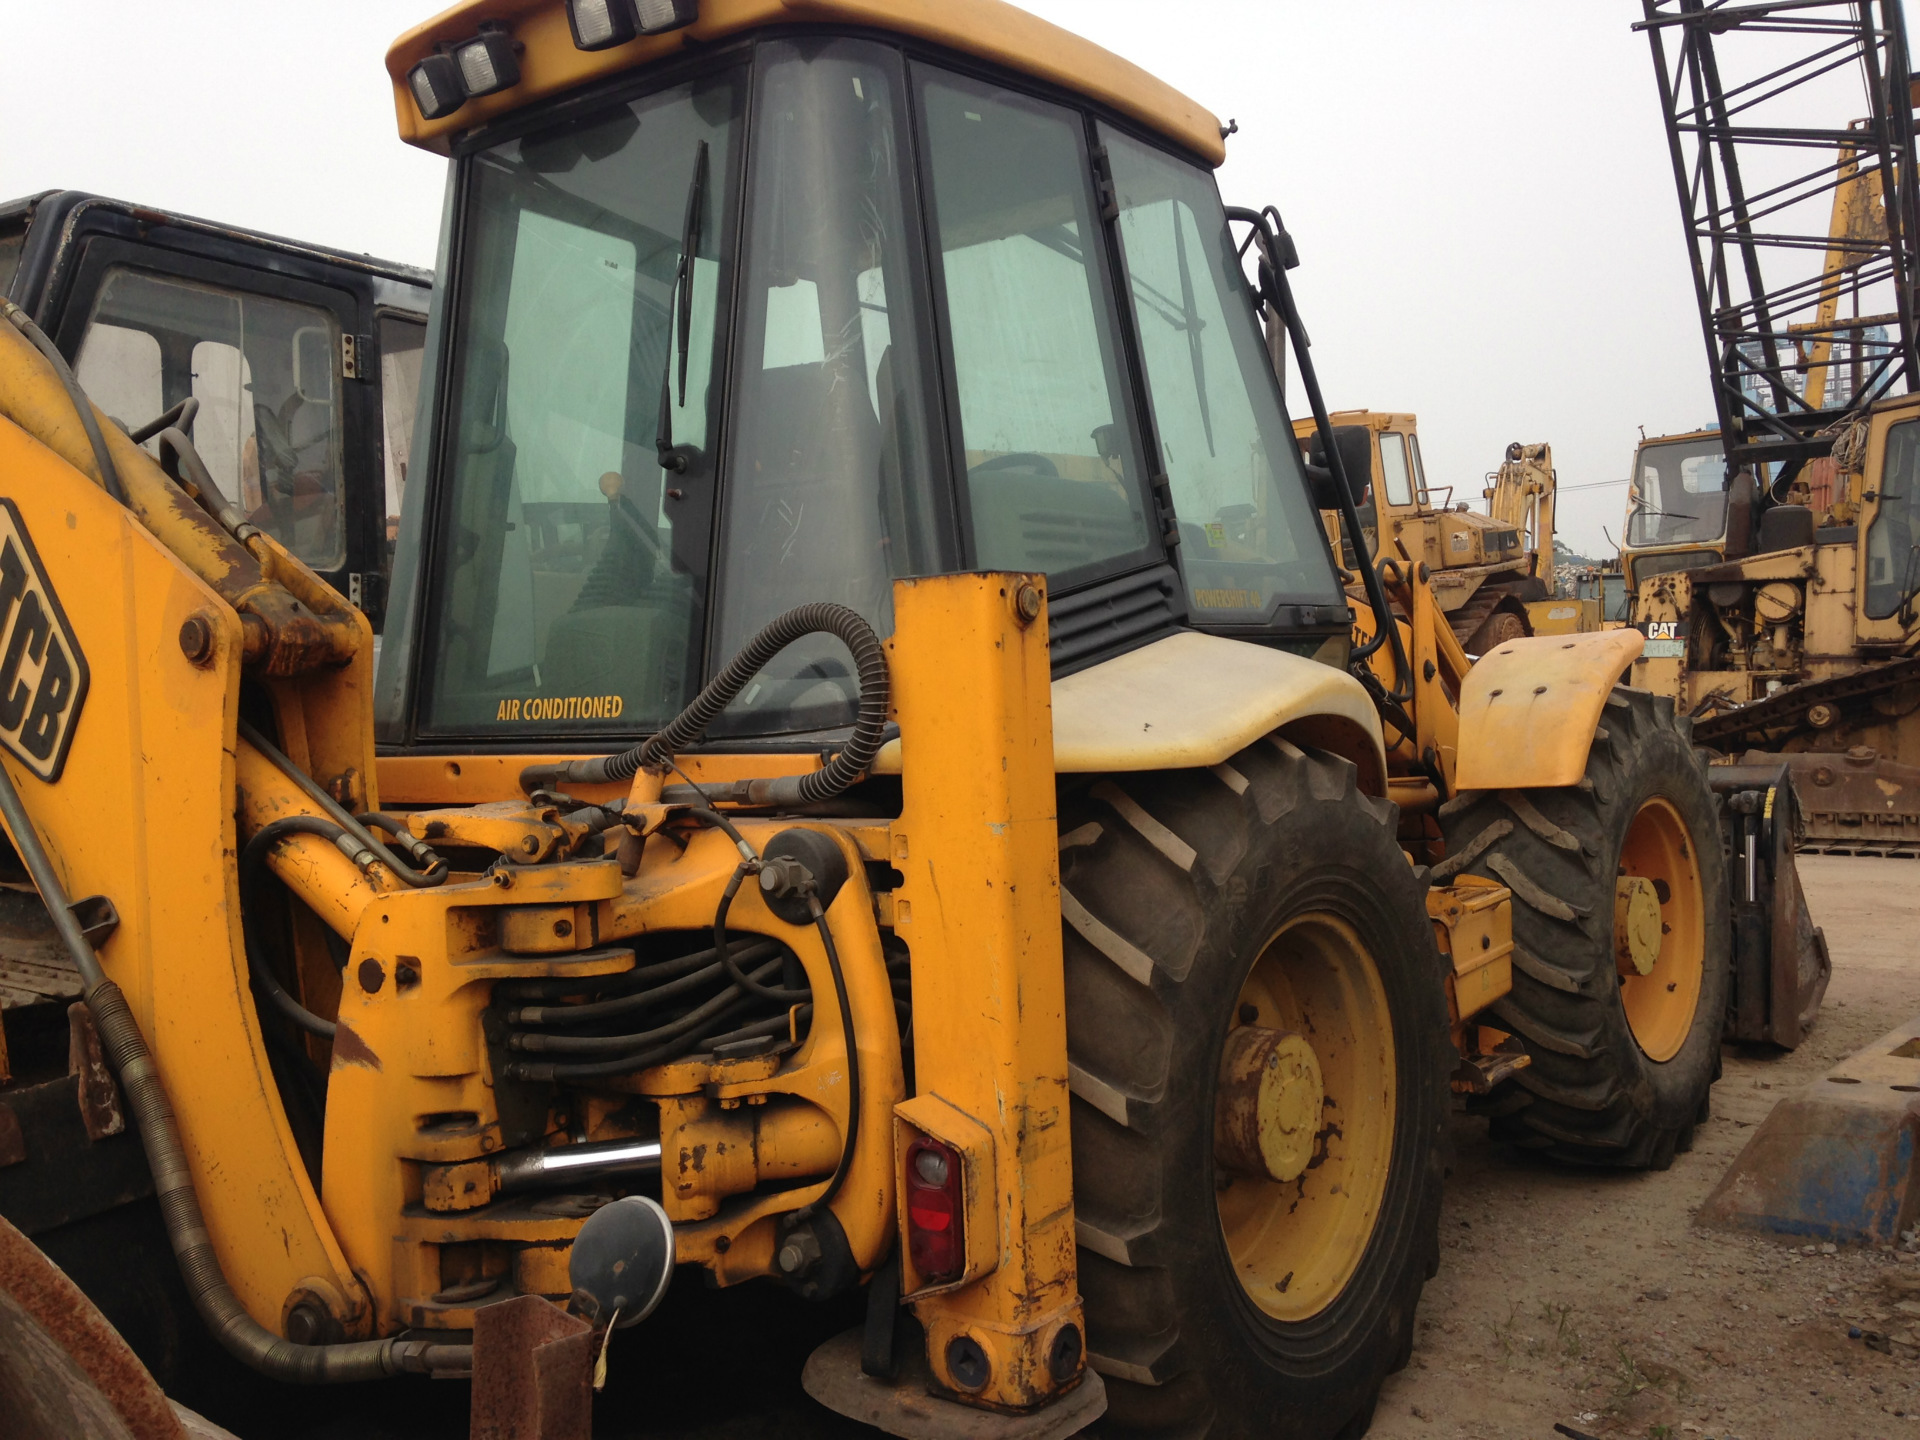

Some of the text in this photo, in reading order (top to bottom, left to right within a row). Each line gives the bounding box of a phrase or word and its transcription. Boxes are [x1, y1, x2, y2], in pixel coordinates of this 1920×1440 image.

[1195, 588, 1262, 608] POWERSHIFT 40
[1648, 622, 1677, 639] CAT
[497, 695, 623, 721] AIR CONDITIONED
